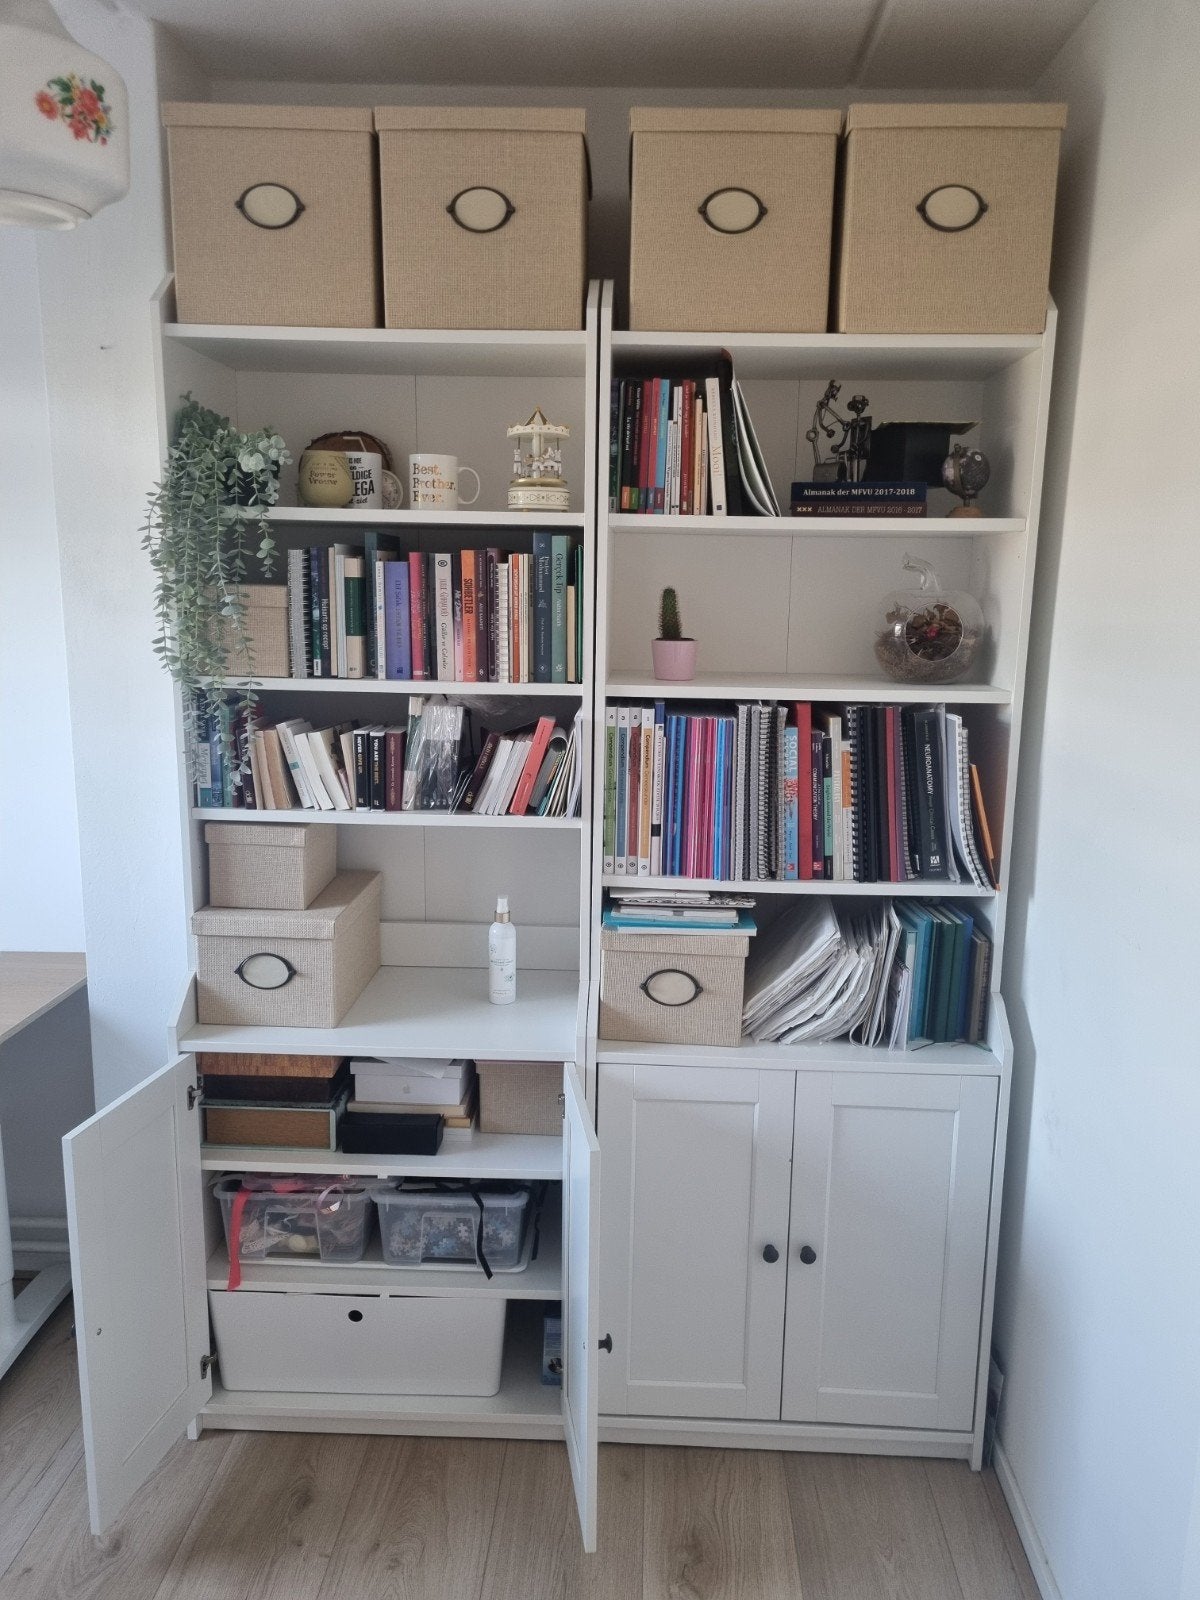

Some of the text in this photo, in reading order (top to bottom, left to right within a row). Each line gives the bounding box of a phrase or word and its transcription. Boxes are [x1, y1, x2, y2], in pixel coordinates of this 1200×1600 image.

[352, 469, 372, 481] LDIGE
[412, 463, 442, 475] Best.
[352, 480, 375, 497] EGA
[412, 477, 456, 491] Brother.
[851, 488, 873, 496] MFVU
[875, 488, 915, 496] 2017-2018
[554, 553, 564, 580] Gerçek
[463, 578, 473, 614] SOHBETLER
[554, 582, 564, 594] Tıp
[321, 599, 329, 622] Huisarts
[790, 735, 798, 772] SOCIAL
[925, 744, 934, 795] NEUROANATOMY
